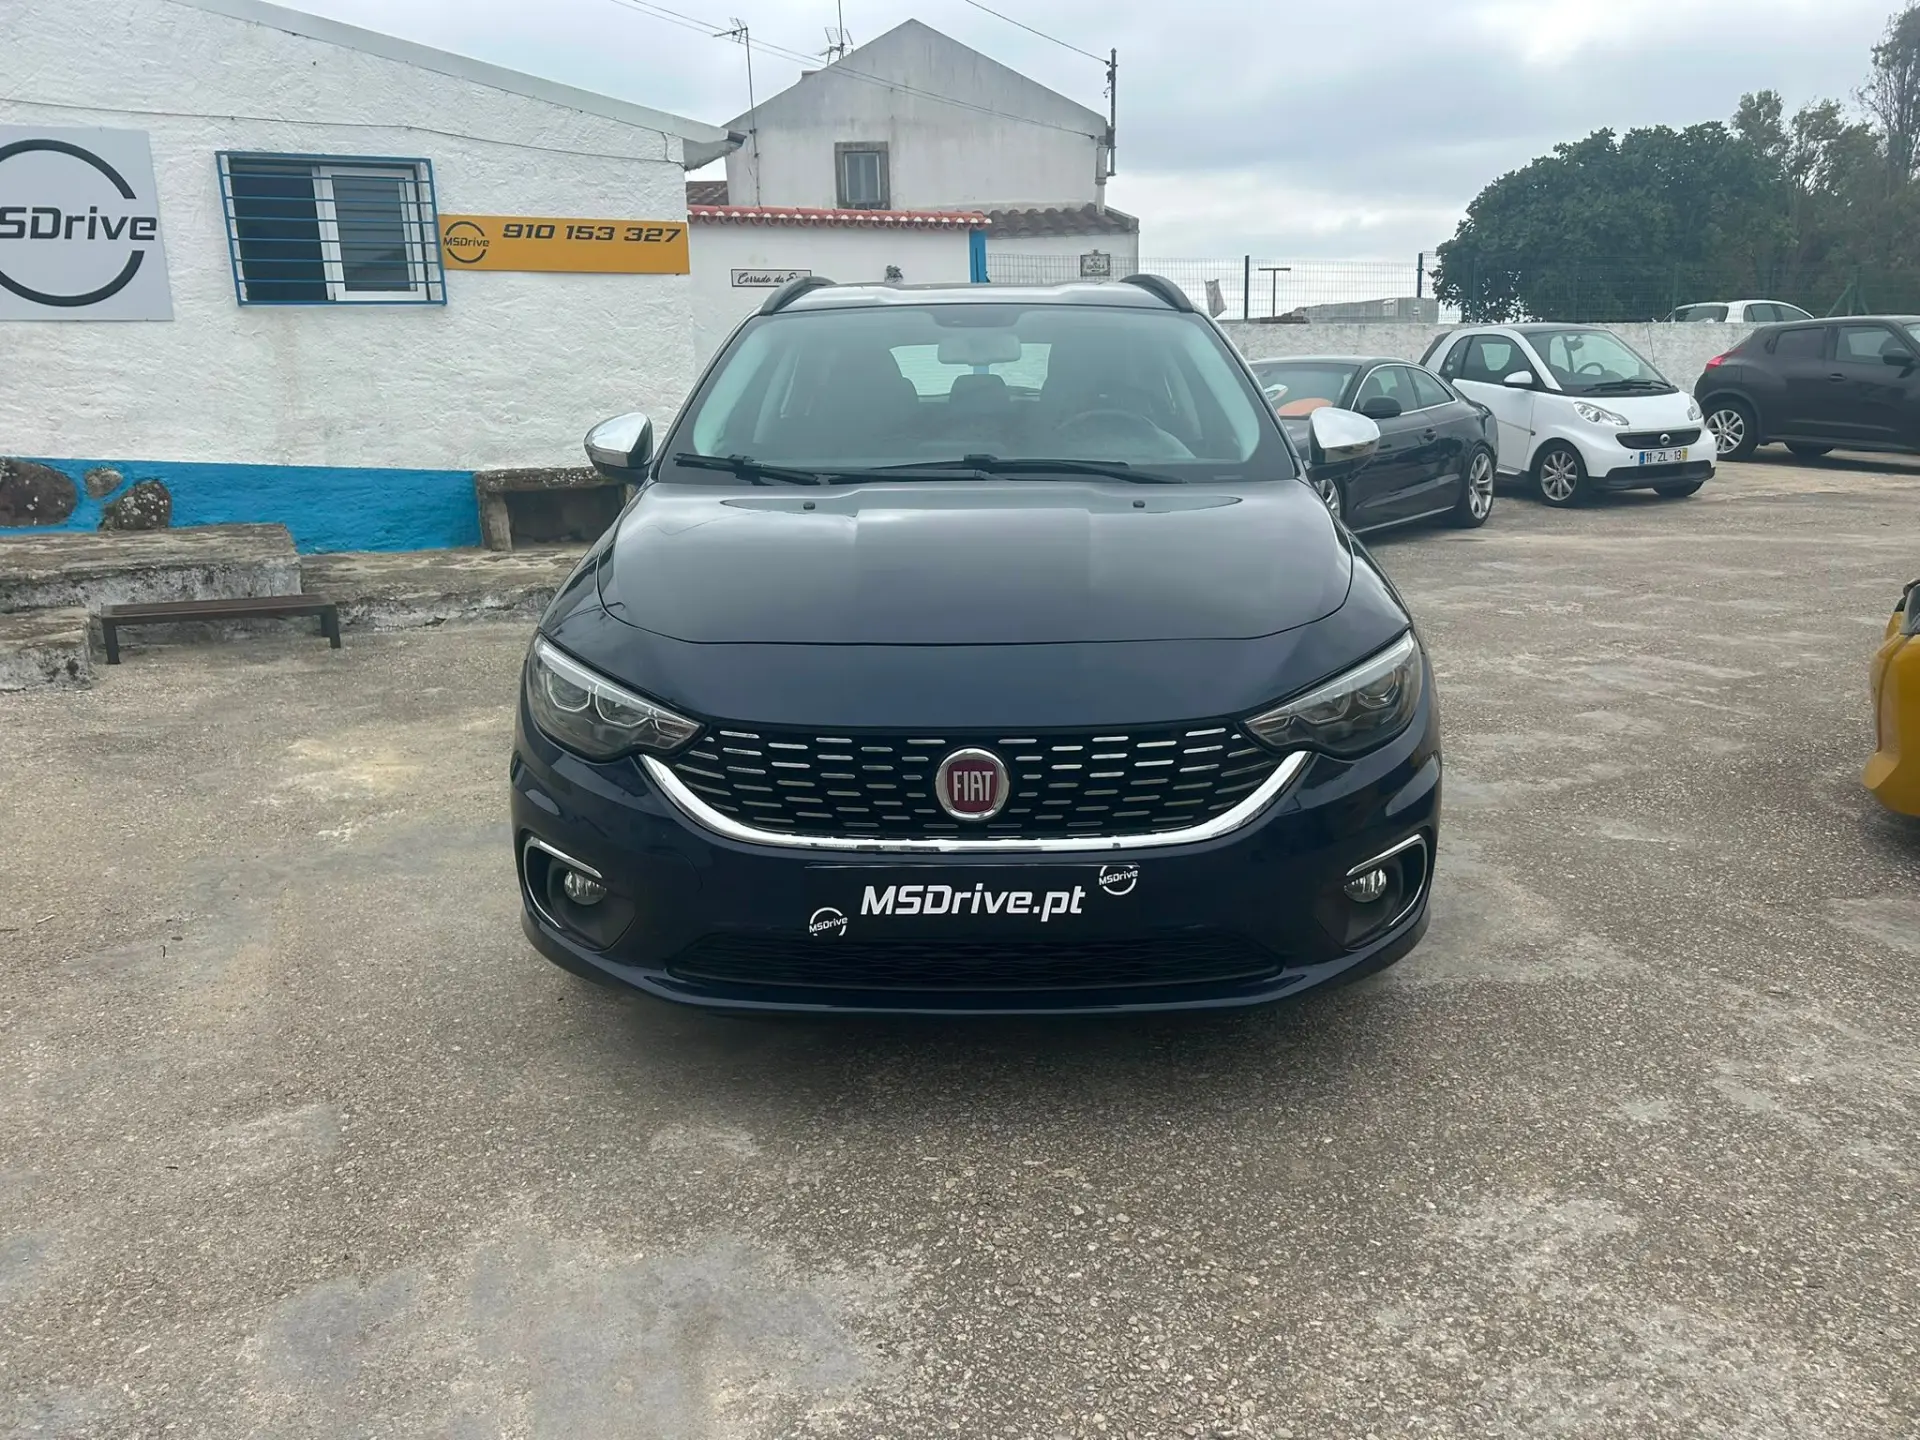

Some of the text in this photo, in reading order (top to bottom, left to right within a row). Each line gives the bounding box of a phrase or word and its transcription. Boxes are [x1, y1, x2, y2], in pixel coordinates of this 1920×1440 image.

[443, 236, 490, 248] MSDrive
[503, 223, 681, 243] 910 153 327
[953, 771, 994, 802] FIAT
[1098, 868, 1139, 887] MSDrive
[860, 883, 1087, 922] MSDrive.pt
[809, 915, 848, 934] MSDrive
